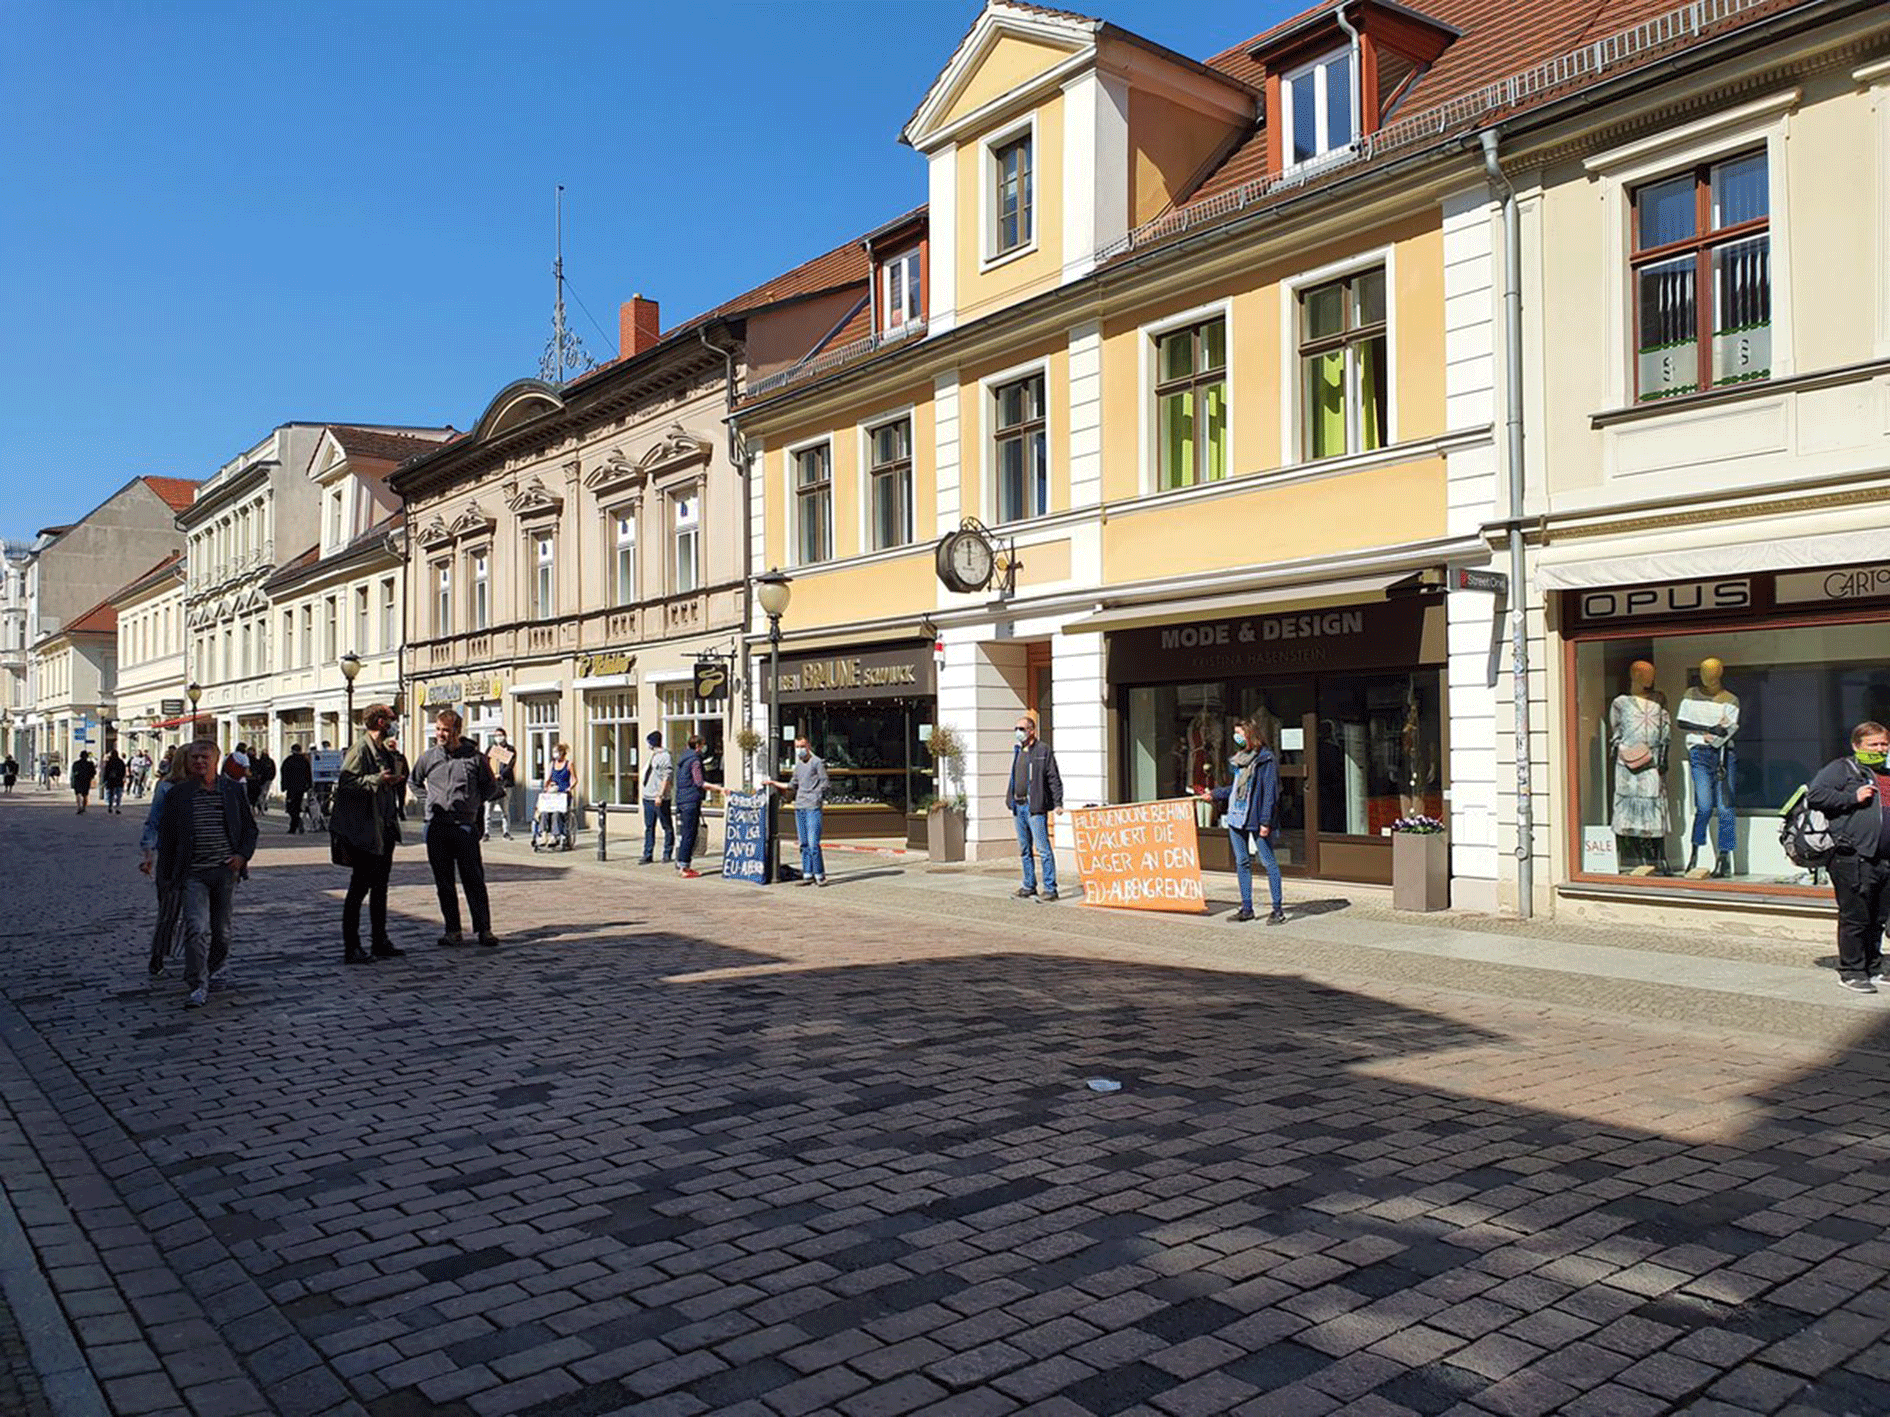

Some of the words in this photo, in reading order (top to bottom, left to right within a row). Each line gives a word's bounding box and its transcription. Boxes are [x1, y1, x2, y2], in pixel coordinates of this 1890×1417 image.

[1467, 574, 1490, 587] Street
[1584, 582, 1749, 618] OPUS
[1161, 625, 1230, 649] MODE
[1238, 622, 1256, 643] &
[1263, 611, 1363, 641] DESIGN
[802, 657, 861, 690] BRAUNE
[1154, 823, 1176, 844] DIE
[1585, 840, 1612, 852] SALE
[1080, 852, 1134, 875] LAGER
[1140, 850, 1160, 871] AN
[1163, 847, 1196, 869] DEN
